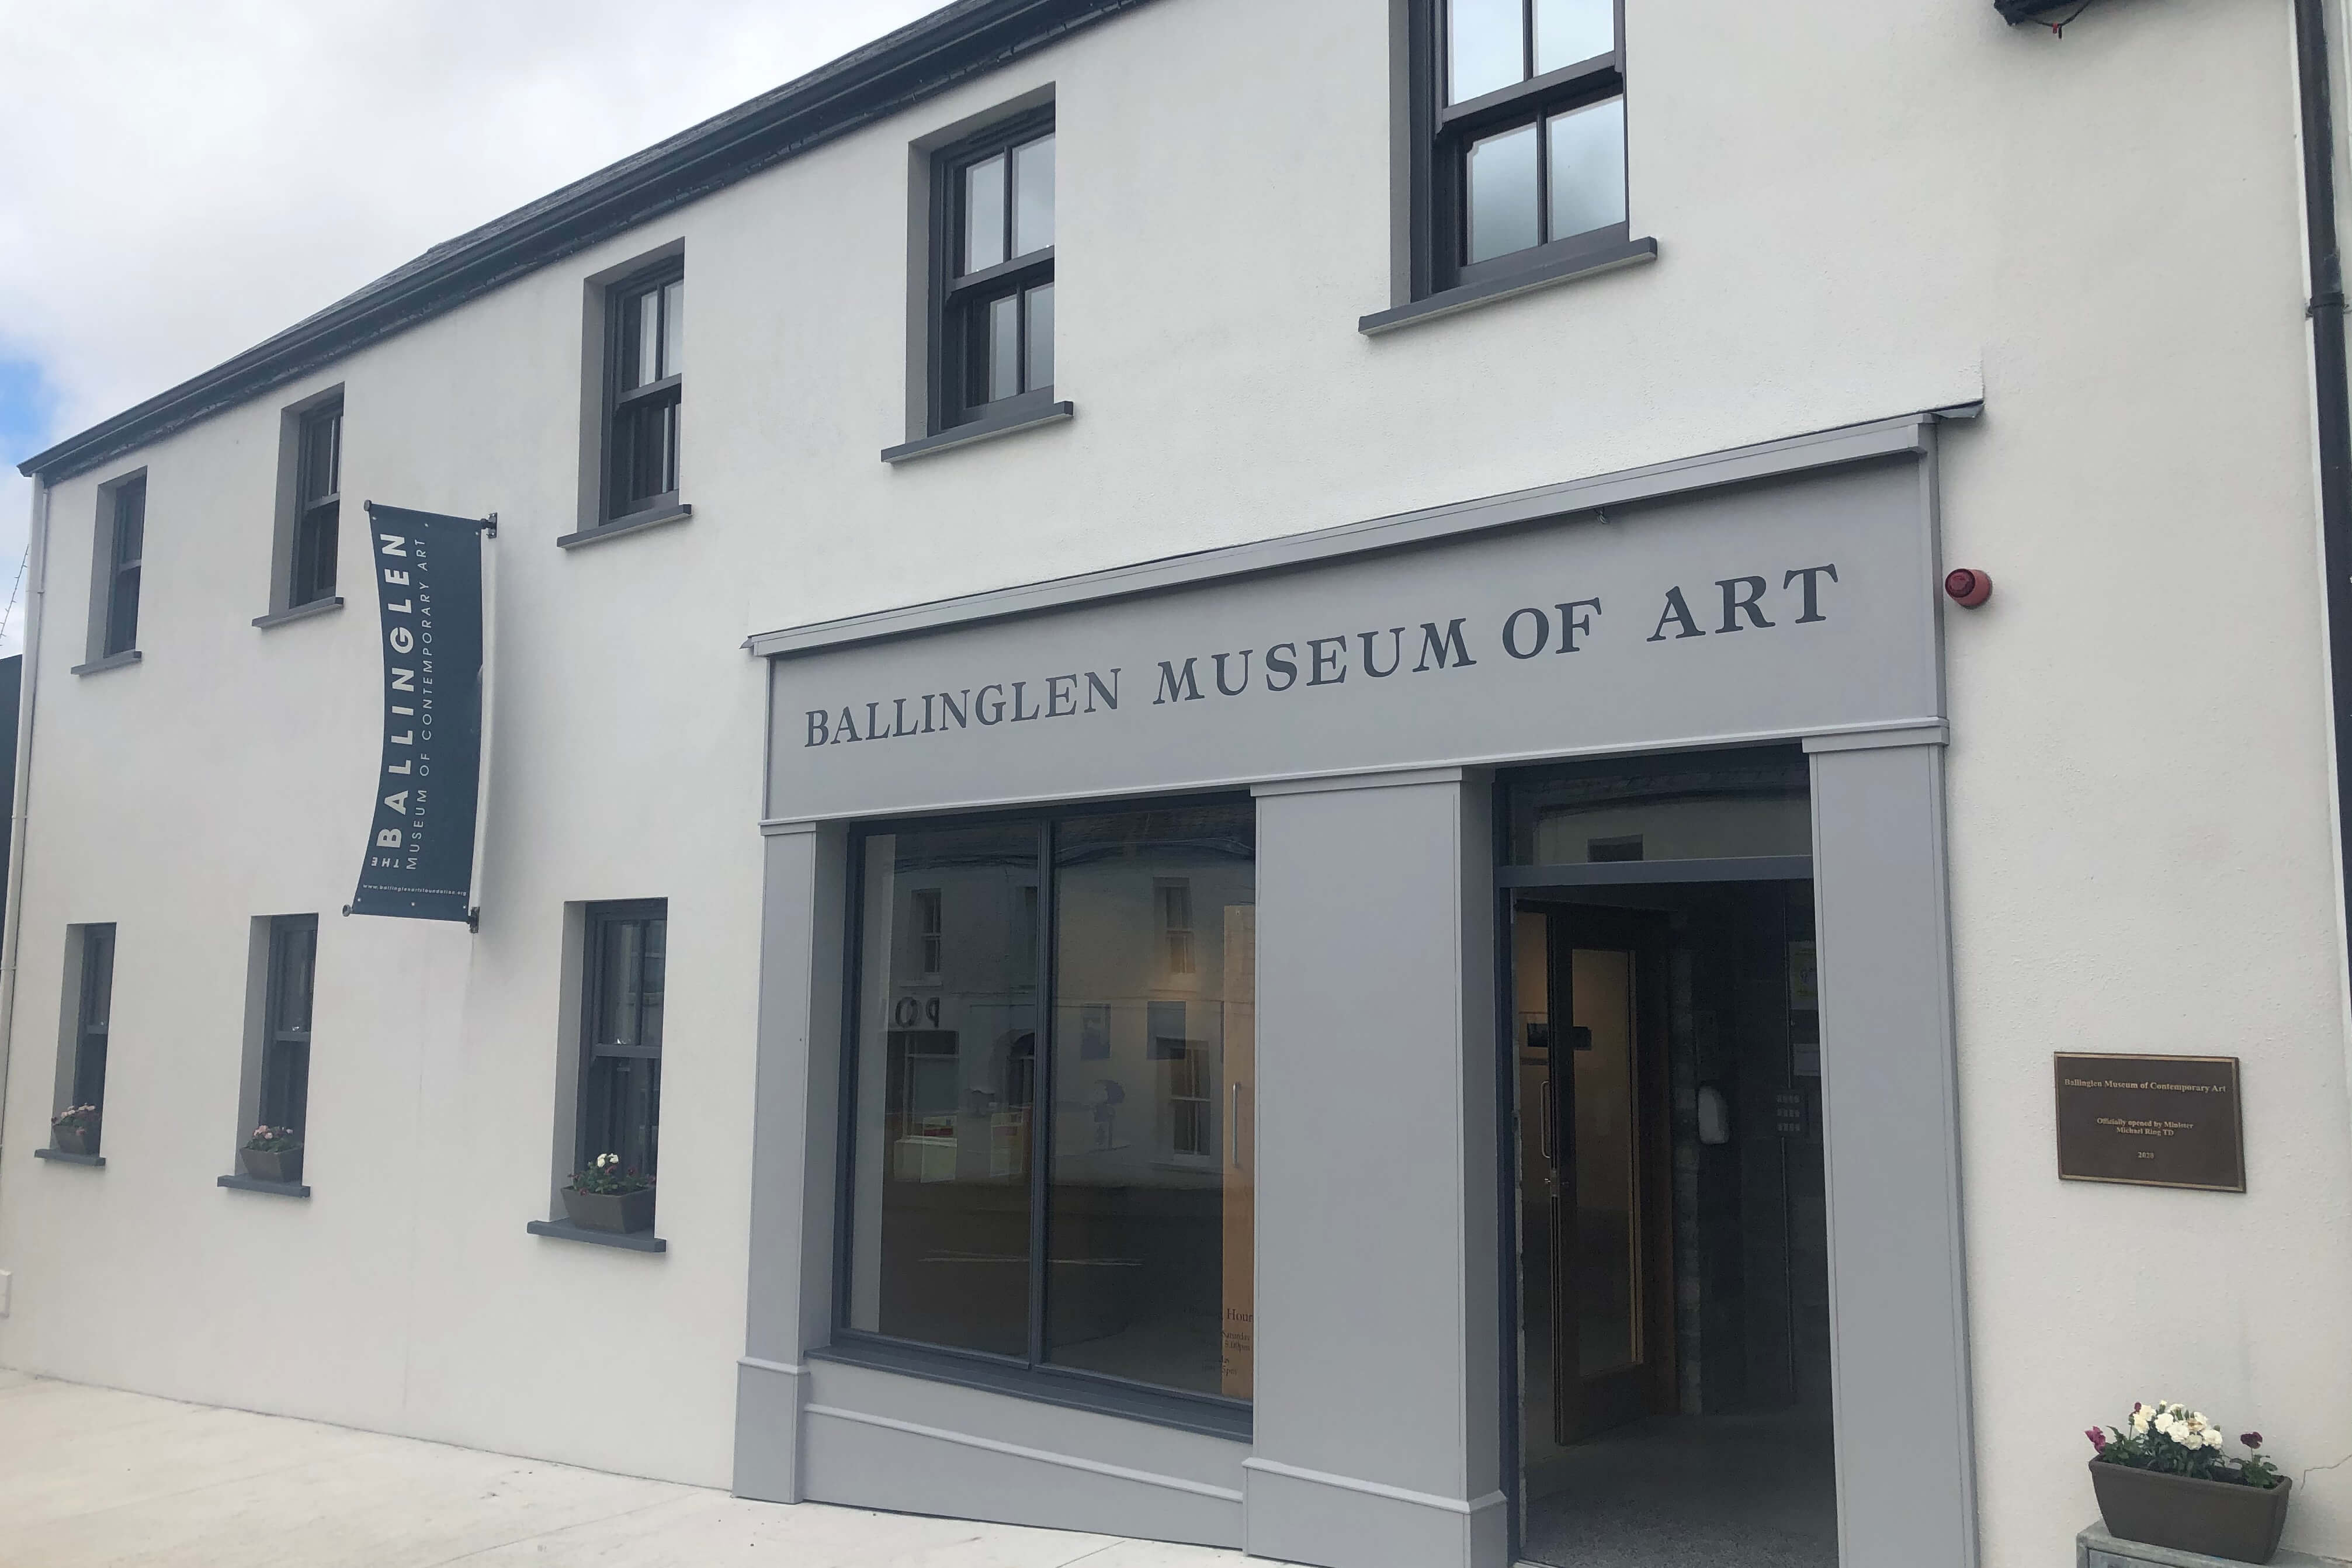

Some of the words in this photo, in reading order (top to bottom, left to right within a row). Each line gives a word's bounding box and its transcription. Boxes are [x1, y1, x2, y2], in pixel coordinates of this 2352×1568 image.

[414, 539, 428, 572] ART
[418, 581, 433, 741] CONTEMPORARY
[804, 667, 1122, 748] BALLINGLEN
[1152, 617, 1478, 706] MUSEUM
[1501, 596, 1602, 660] OF
[1646, 563, 1839, 643] ART
[376, 533, 415, 849] BALLINGLEN
[419, 752, 430, 777] OF
[406, 789, 428, 870] MUSEUM
[370, 856, 400, 869] THE
[2064, 1078, 2103, 1088] Ballinglen
[2104, 1080, 2138, 1089] Museum
[2140, 1081, 2149, 1090] of
[2150, 1082, 2210, 1094] Contemporary
[2096, 1117, 2126, 1127] Officially
[2128, 1119, 2152, 1128] opened
[2153, 1121, 2162, 1129] by
[2163, 1121, 2194, 1129] Minister
[2116, 1126, 2143, 1135] Michael
[2145, 1128, 2162, 1137] Ring
[2162, 1128, 2174, 1136] TD
